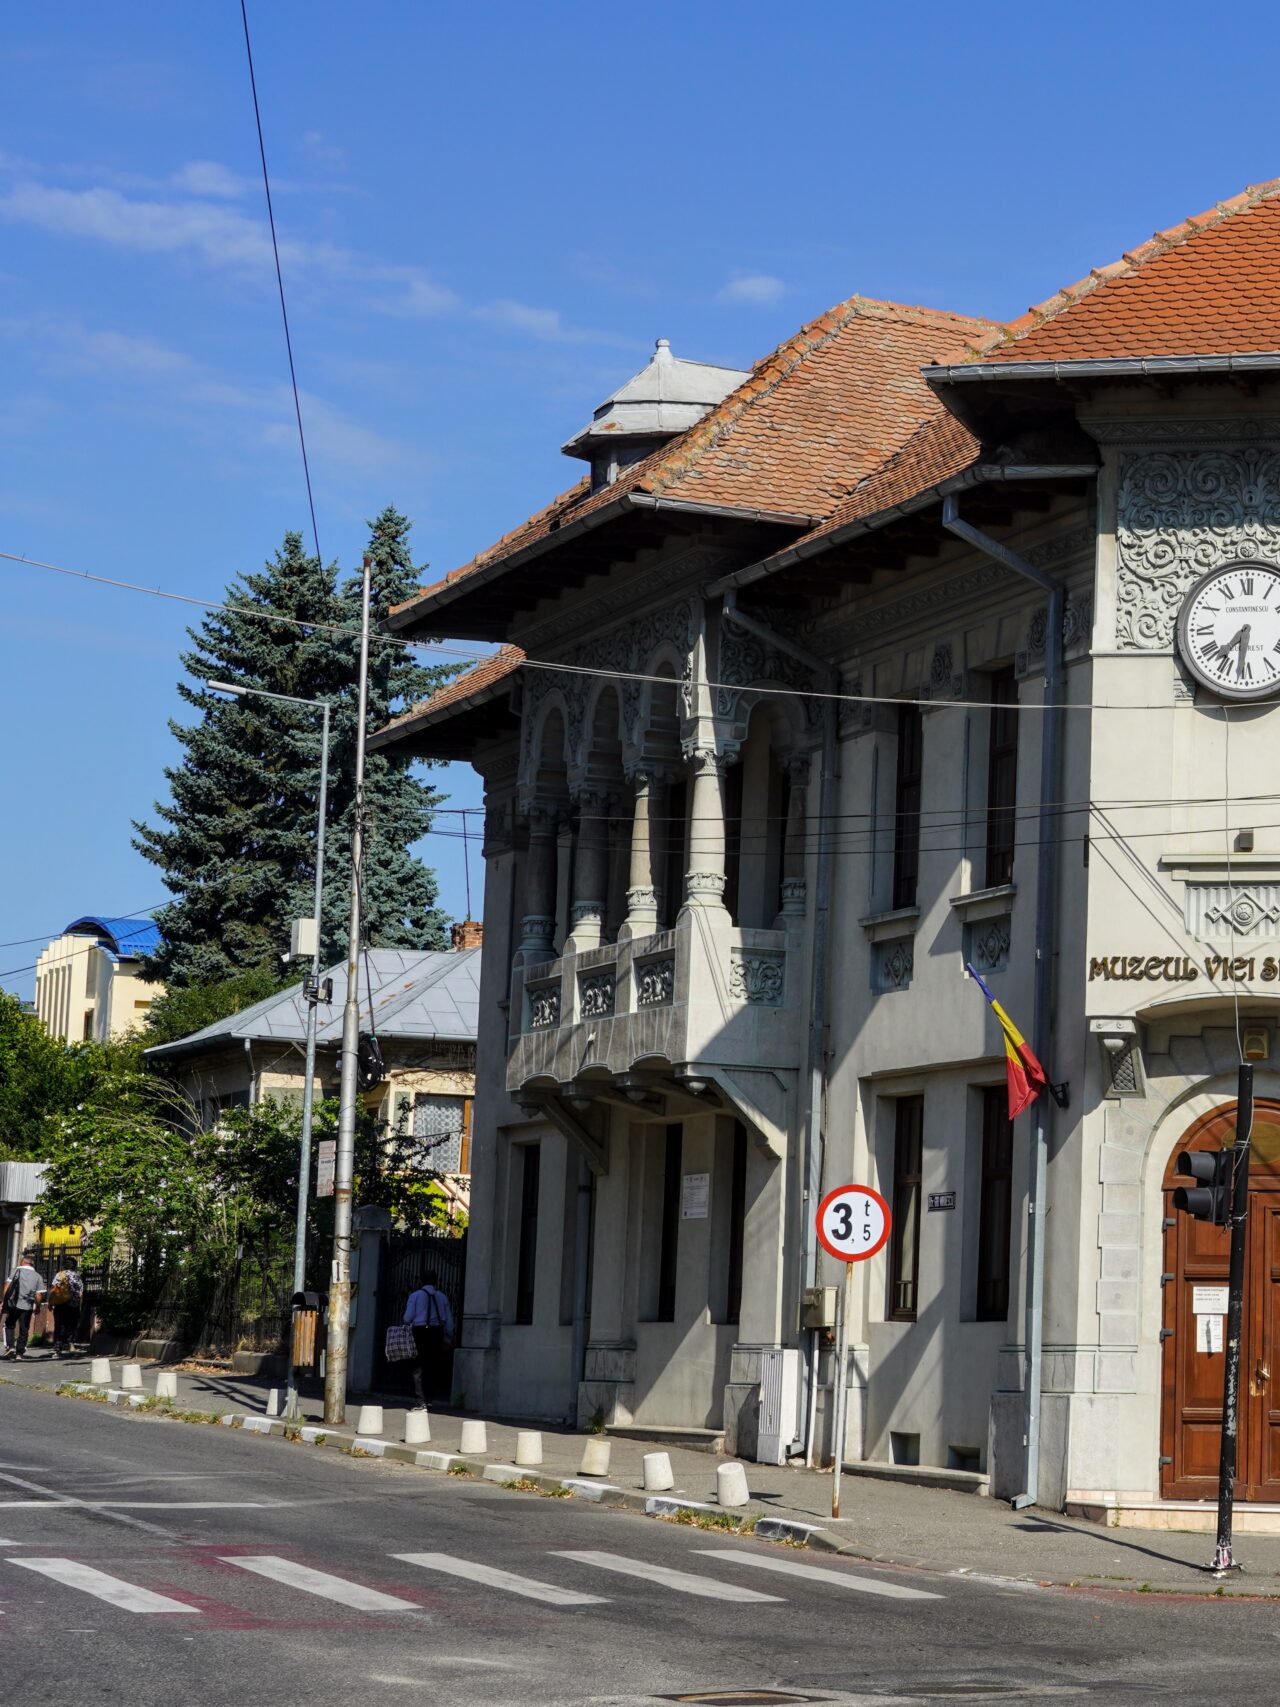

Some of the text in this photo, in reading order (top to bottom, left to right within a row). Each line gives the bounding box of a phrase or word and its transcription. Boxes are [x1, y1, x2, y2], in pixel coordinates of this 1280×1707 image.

[1088, 956, 1199, 981] MUZEUL
[1204, 956, 1255, 981] VIEI
[865, 1200, 871, 1217] t
